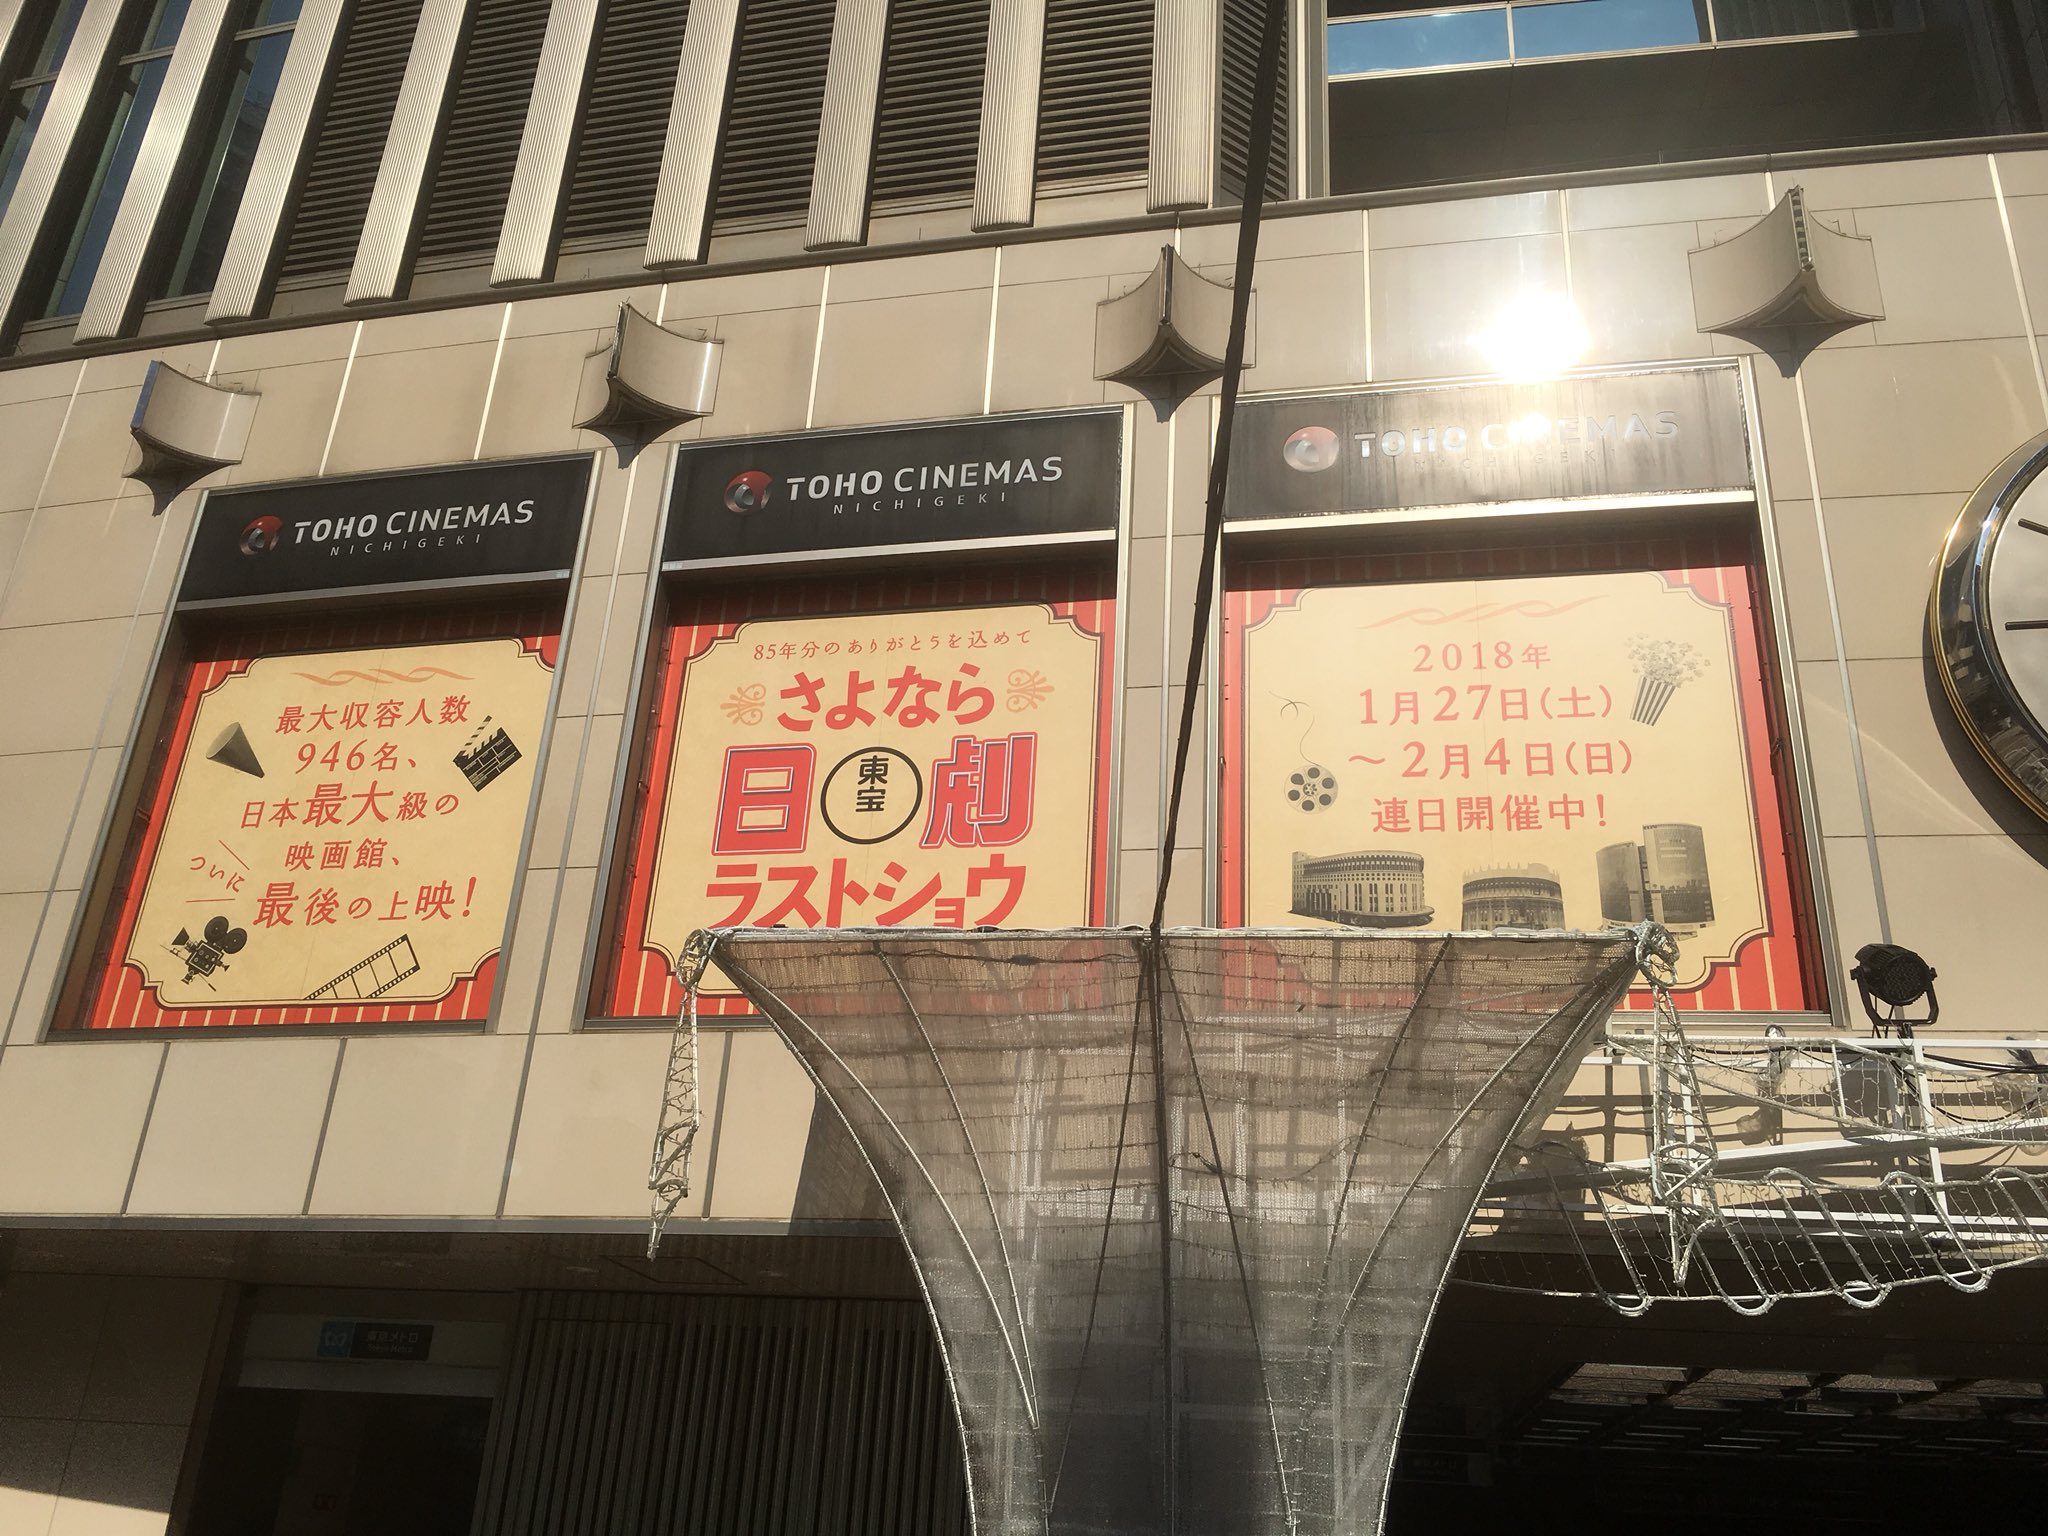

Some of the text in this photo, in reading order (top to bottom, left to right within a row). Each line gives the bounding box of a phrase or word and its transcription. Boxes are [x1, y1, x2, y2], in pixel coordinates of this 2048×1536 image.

[1354, 410, 1679, 459] TOHO CEMAS
[787, 456, 1063, 502] TOHO CINEMAS
[294, 500, 535, 545] TOHO CINEMAS
[833, 490, 1006, 515] NICHIGEKI
[330, 533, 482, 557] NICHIGEKI
[753, 629, 1031, 661] 85年分のありがとうを込めて
[1413, 641, 1551, 673] 2018年
[275, 695, 471, 735] 最大収容人数
[777, 663, 995, 731] さよなら
[1359, 684, 1612, 726] 1月27日(土)
[294, 740, 418, 775] 946名、
[855, 755, 889, 812] 東宝
[240, 780, 460, 829] 日本最大級の
[1371, 793, 1607, 833] 連日開催中!
[189, 856, 246, 893] ついに
[284, 838, 401, 872] 映画館、
[253, 876, 477, 929] 最後の上映!
[705, 853, 1026, 927] ラストショウ
